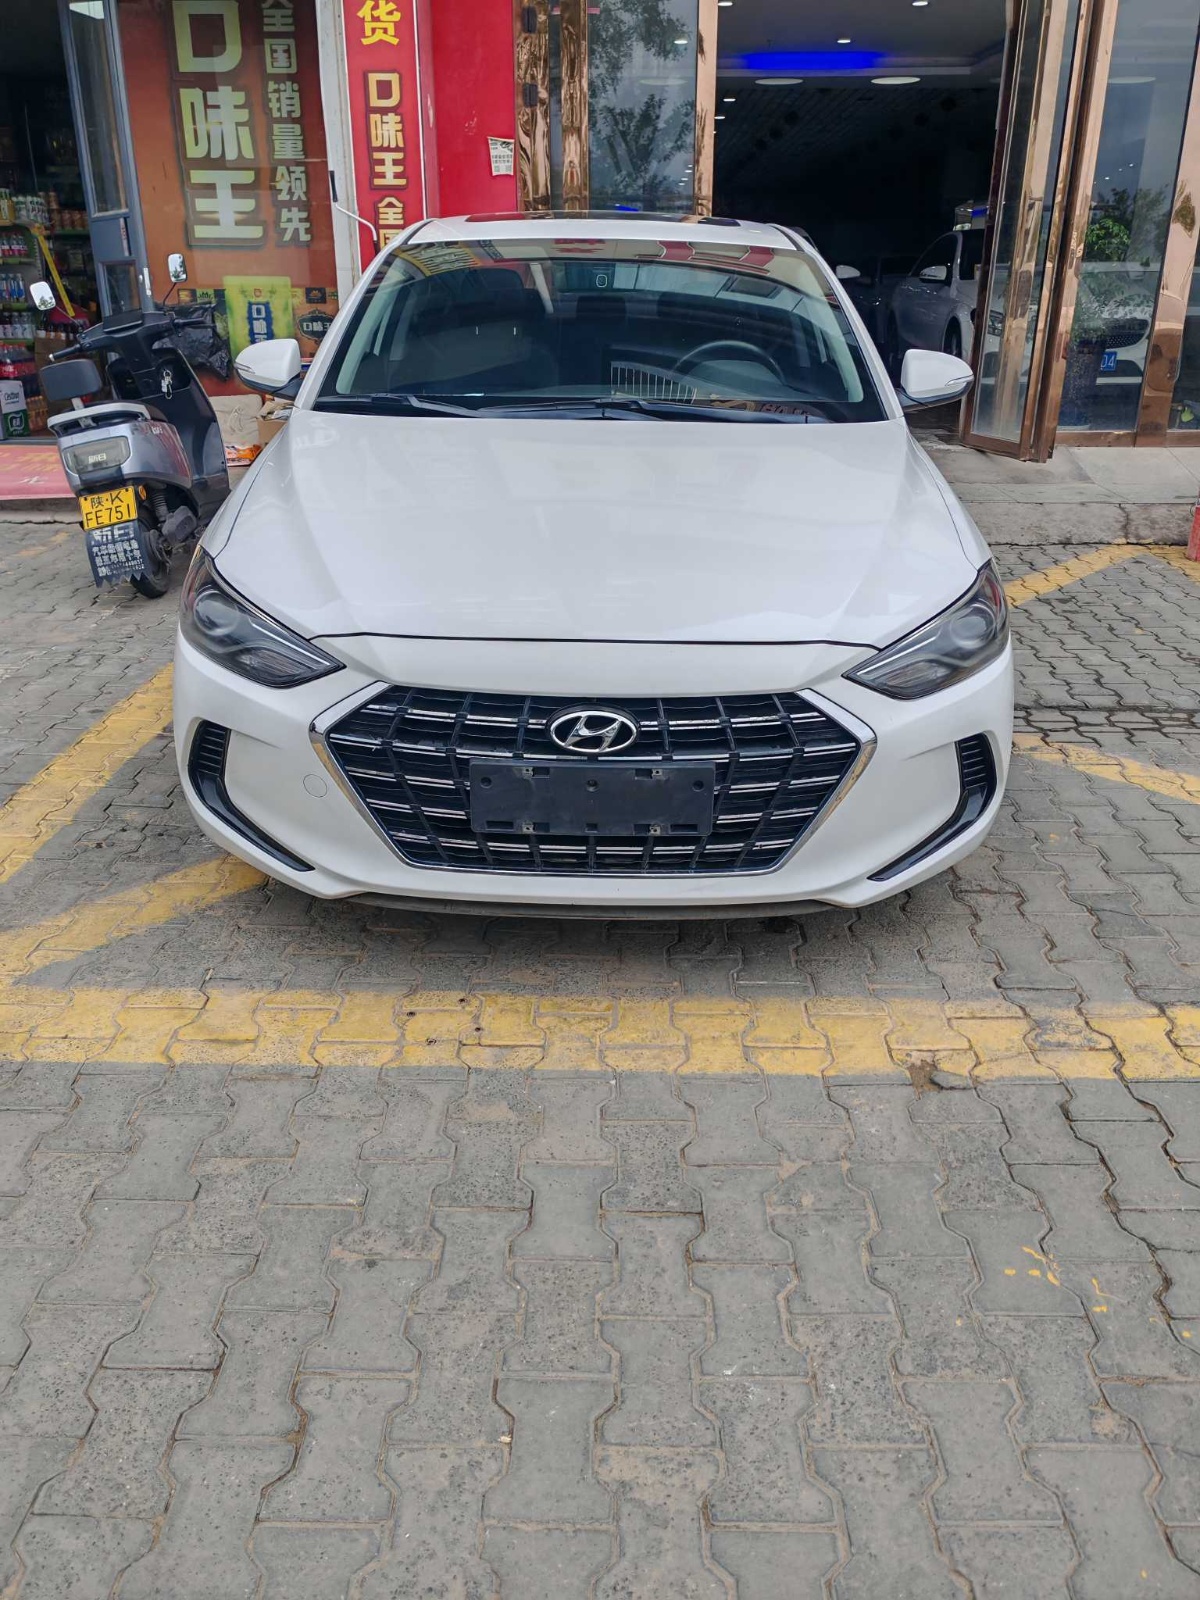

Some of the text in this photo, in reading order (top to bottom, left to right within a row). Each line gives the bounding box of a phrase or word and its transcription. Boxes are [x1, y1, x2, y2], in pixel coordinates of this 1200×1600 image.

[357, 0, 402, 46] 货
[172, 0, 263, 239] 口味王
[261, 0, 312, 242] 全国销量领先
[85, 503, 134, 528] FE751
